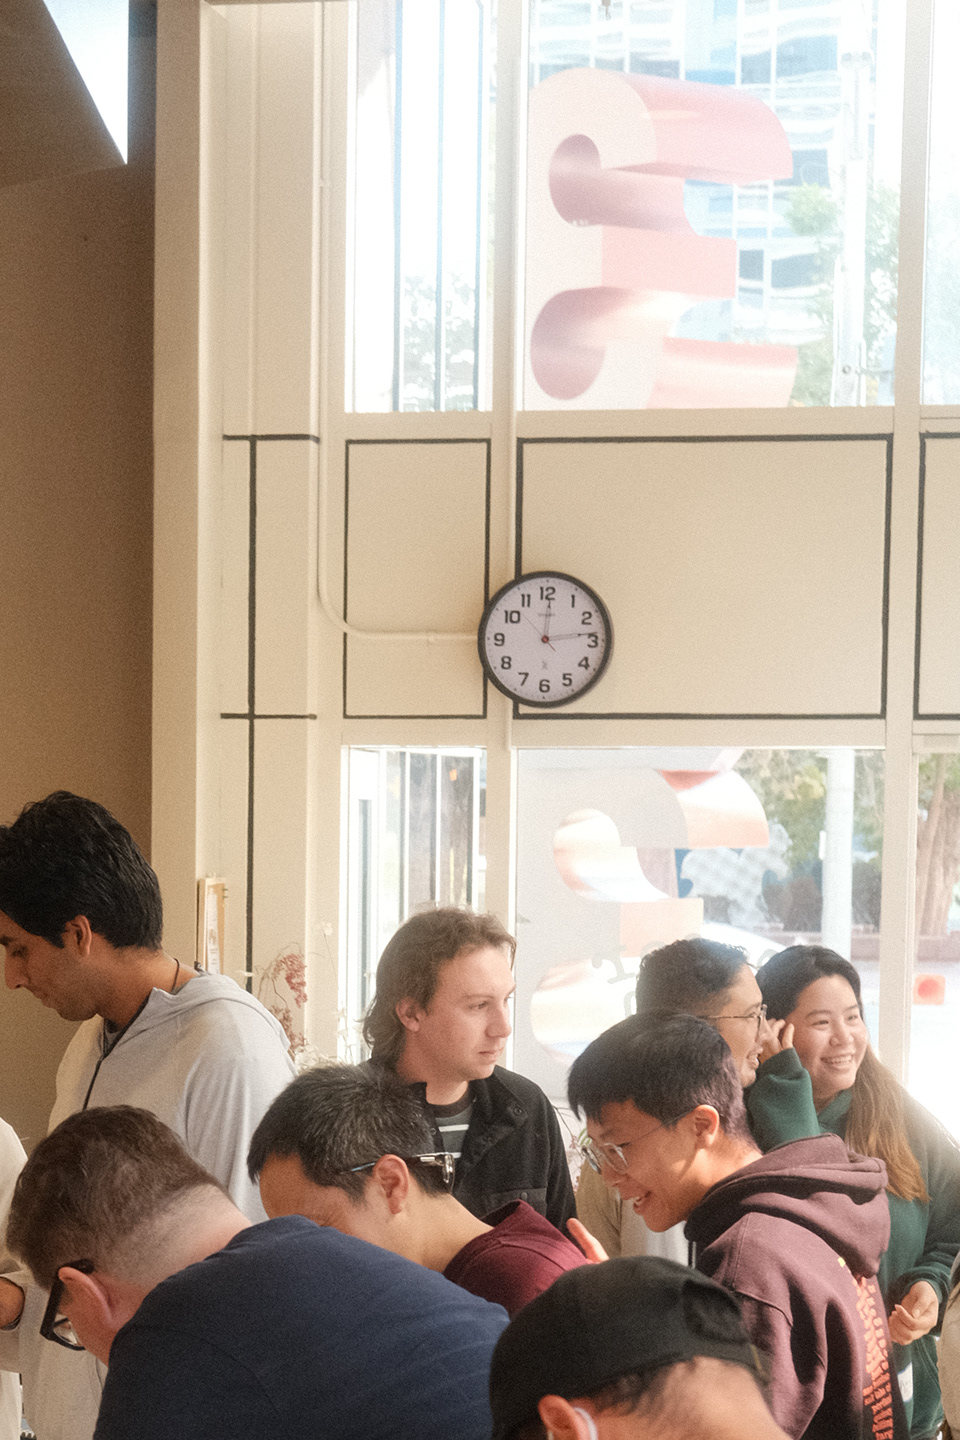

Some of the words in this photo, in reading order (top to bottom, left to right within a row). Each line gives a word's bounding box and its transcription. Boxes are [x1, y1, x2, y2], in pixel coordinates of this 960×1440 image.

[539, 586, 556, 601] 12
[521, 594, 531, 608] 11
[570, 594, 576, 608] 1
[504, 610, 521, 624] 10
[581, 611, 593, 625] 2
[493, 633, 505, 647] 9
[587, 634, 599, 649] 3
[501, 656, 512, 670] 8
[578, 656, 590, 670] 4
[518, 672, 529, 686] 7
[538, 679, 551, 693] 6
[562, 673, 573, 687] 5
